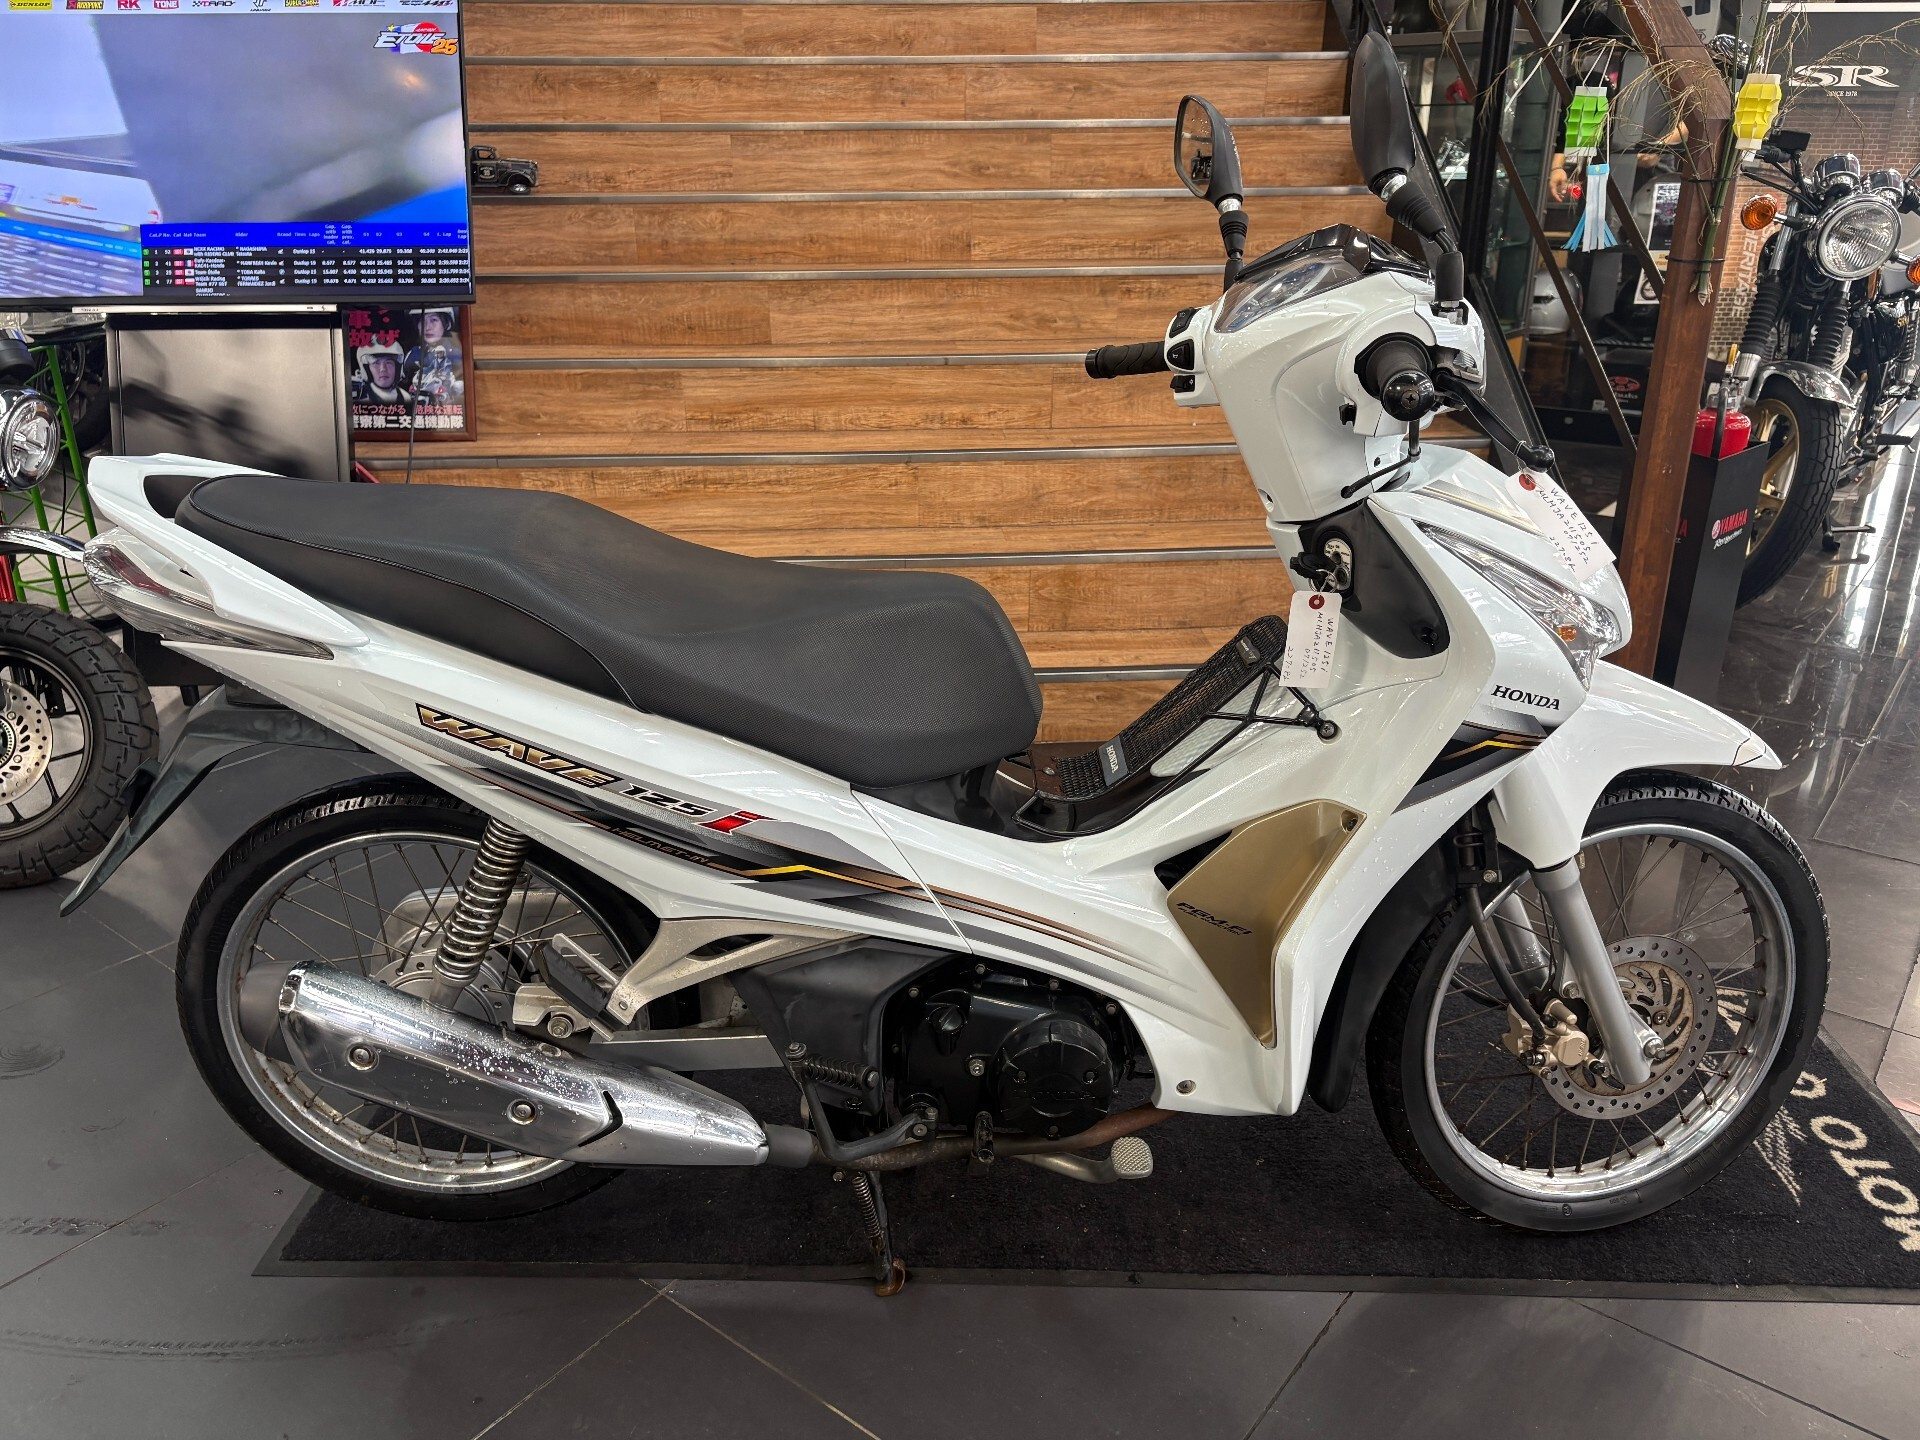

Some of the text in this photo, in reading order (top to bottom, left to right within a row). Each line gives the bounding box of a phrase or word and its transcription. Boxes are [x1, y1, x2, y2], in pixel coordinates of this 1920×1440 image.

[118, 0, 140, 8] RK
[430, 38, 458, 55] 25
[1788, 65, 1900, 88] SR
[1550, 487, 1577, 521] WAVE
[1720, 508, 1748, 535] YAMAHA
[1490, 684, 1561, 711] HONDA
[416, 704, 622, 788] WAVE
[619, 783, 718, 817] 125
[1105, 744, 1119, 774] HONDA
